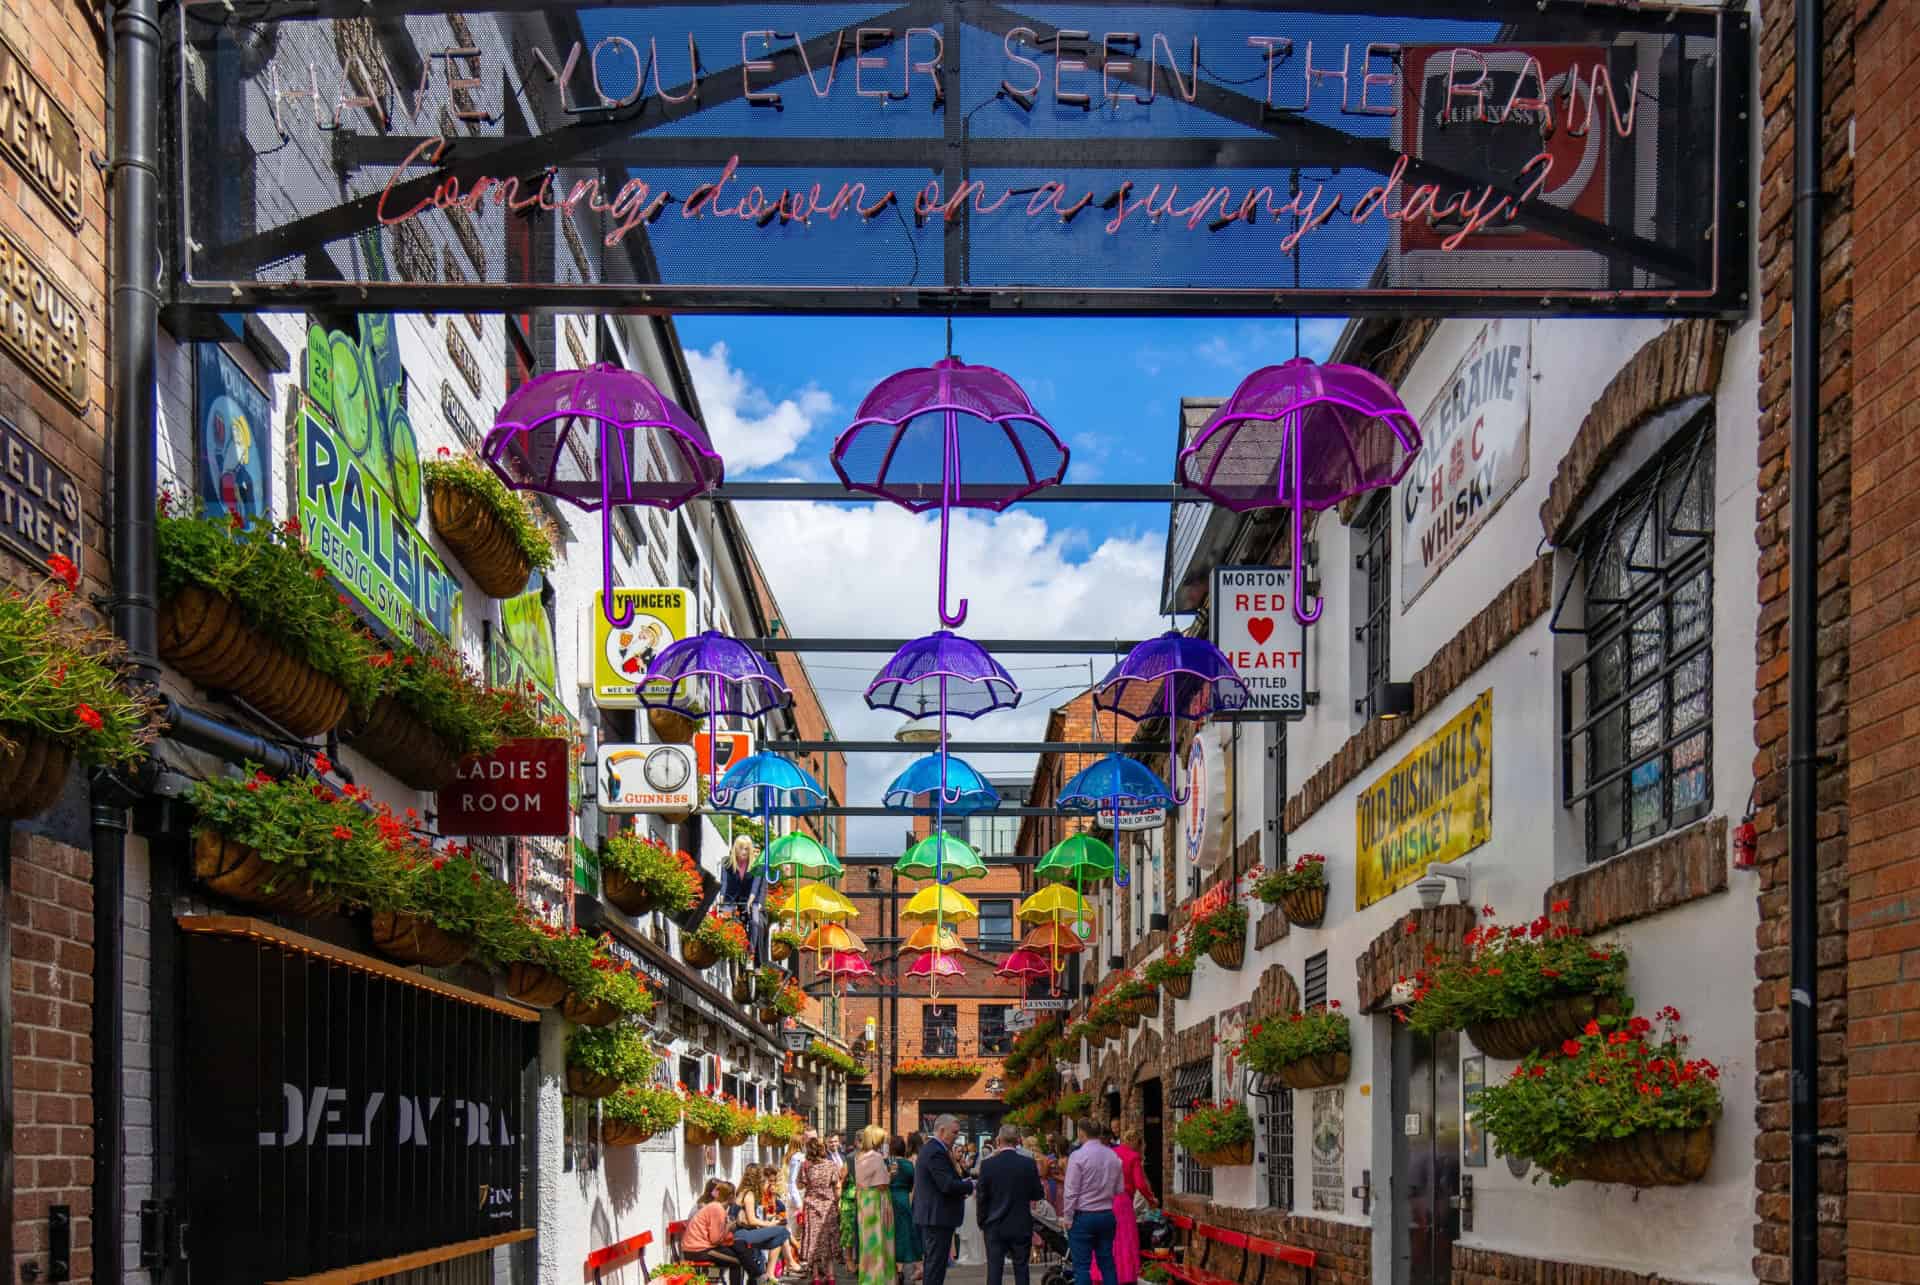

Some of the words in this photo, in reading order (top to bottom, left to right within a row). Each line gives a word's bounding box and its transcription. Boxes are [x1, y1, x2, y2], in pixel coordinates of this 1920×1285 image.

[272, 47, 481, 132] HAVE
[532, 30, 698, 112] YOU
[742, 27, 945, 100] EVER
[1003, 26, 1199, 103] SEEN
[1247, 35, 1399, 115] THE
[1443, 47, 1640, 137] RAIN
[376, 135, 662, 247] Coming
[682, 154, 896, 222] down
[914, 178, 1015, 221] on
[1027, 180, 1093, 218] a
[1104, 180, 1340, 253] sunny
[1405, 345, 1521, 524] COLERAINE
[0, 436, 77, 522] ELLS
[1421, 451, 1497, 569] WHISKY
[1222, 572, 1292, 587] MORTON'
[1235, 594, 1286, 612] RED
[1234, 677, 1287, 689] BOTTLED
[1222, 694, 1300, 709] GUNNESS
[455, 761, 547, 779] LADIES
[462, 793, 541, 812] ROOM
[624, 792, 689, 804] GUINNESS
[1380, 802, 1453, 880] WHISKEY
